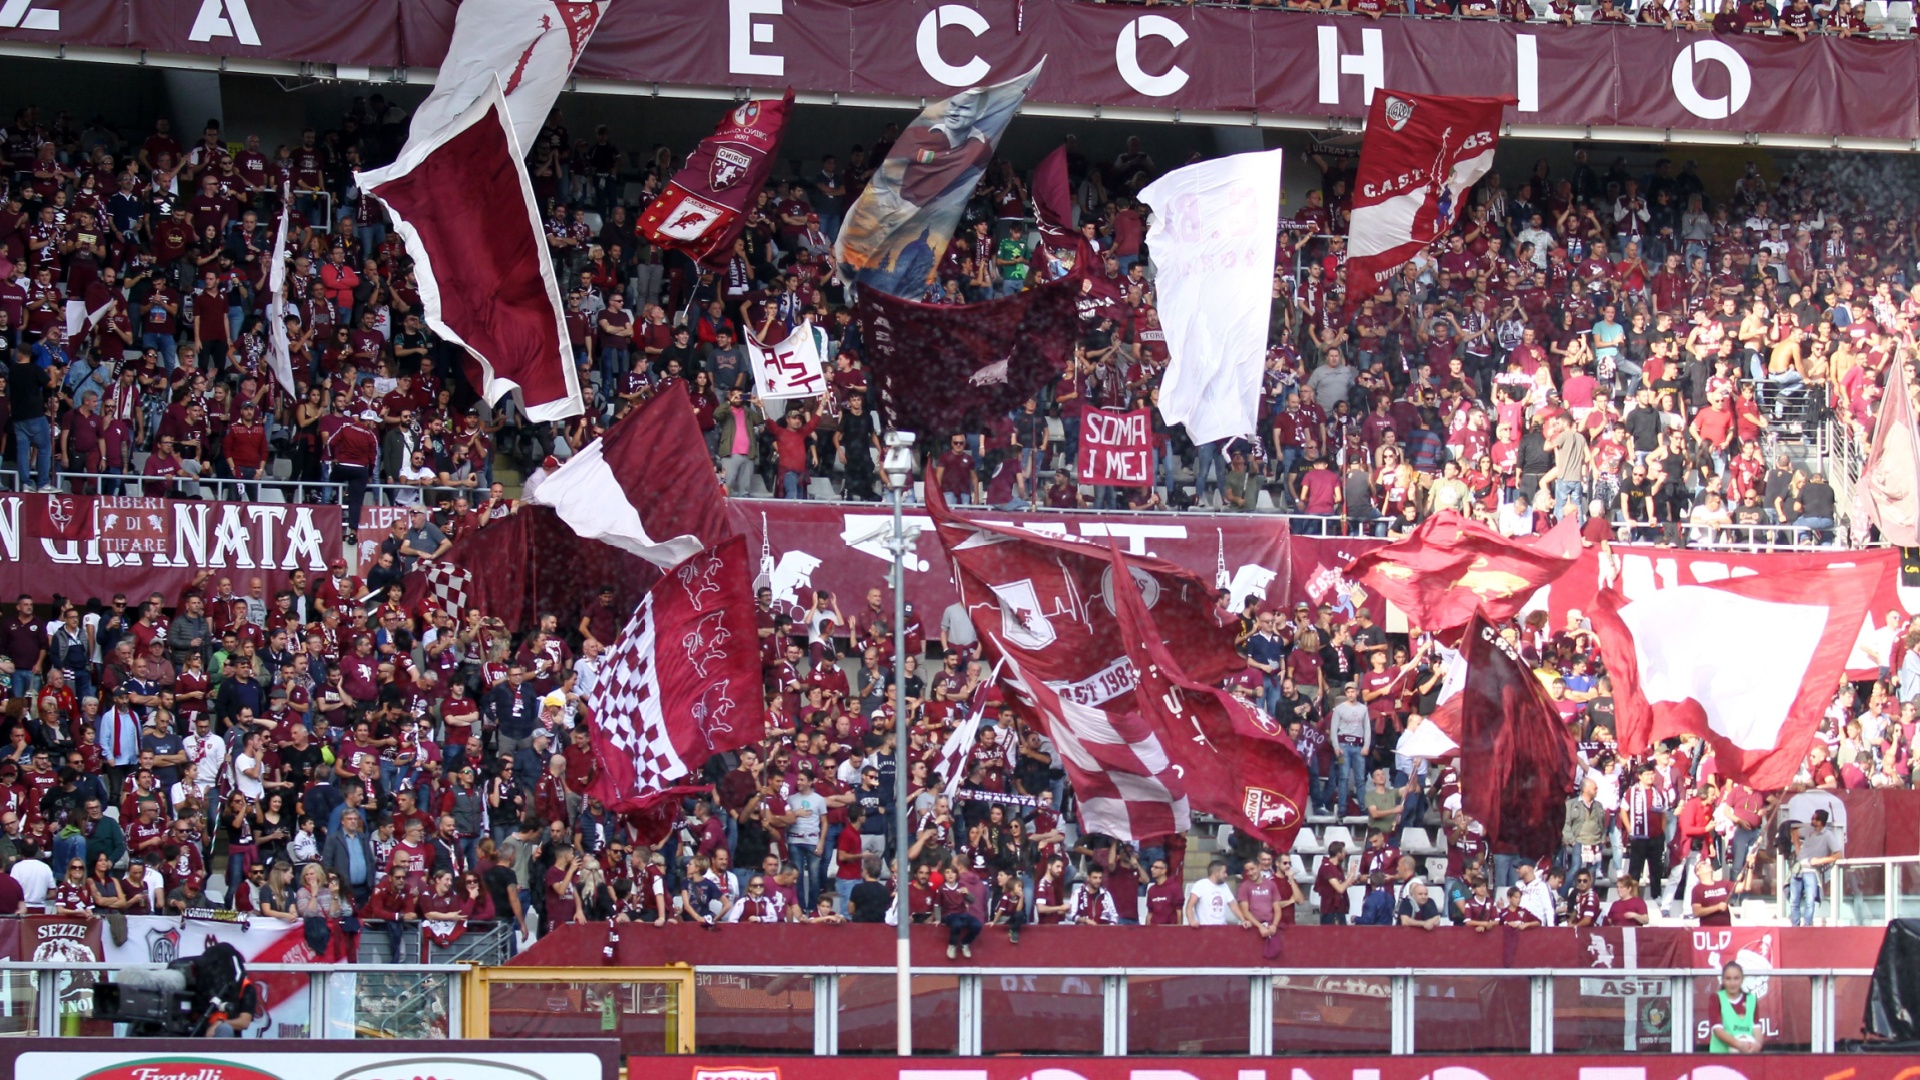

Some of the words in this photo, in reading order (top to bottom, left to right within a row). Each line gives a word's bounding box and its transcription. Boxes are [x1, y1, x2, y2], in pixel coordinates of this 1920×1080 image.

[1086, 413, 1146, 446] SOMA
[1083, 449, 1097, 478] J
[1105, 451, 1147, 480] MEJ
[100, 496, 166, 509] LIBERI
[126, 516, 141, 530] DI
[102, 538, 167, 552] TIFARE
[1303, 725, 1325, 745] TORO
[974, 793, 1036, 807] GRANATA
[1262, 795, 1272, 809] FC
[183, 907, 214, 919] TORINO
[38, 923, 87, 940] SEZZE
[1692, 931, 1732, 951] OLD
[1600, 982, 1663, 995] ASTI
